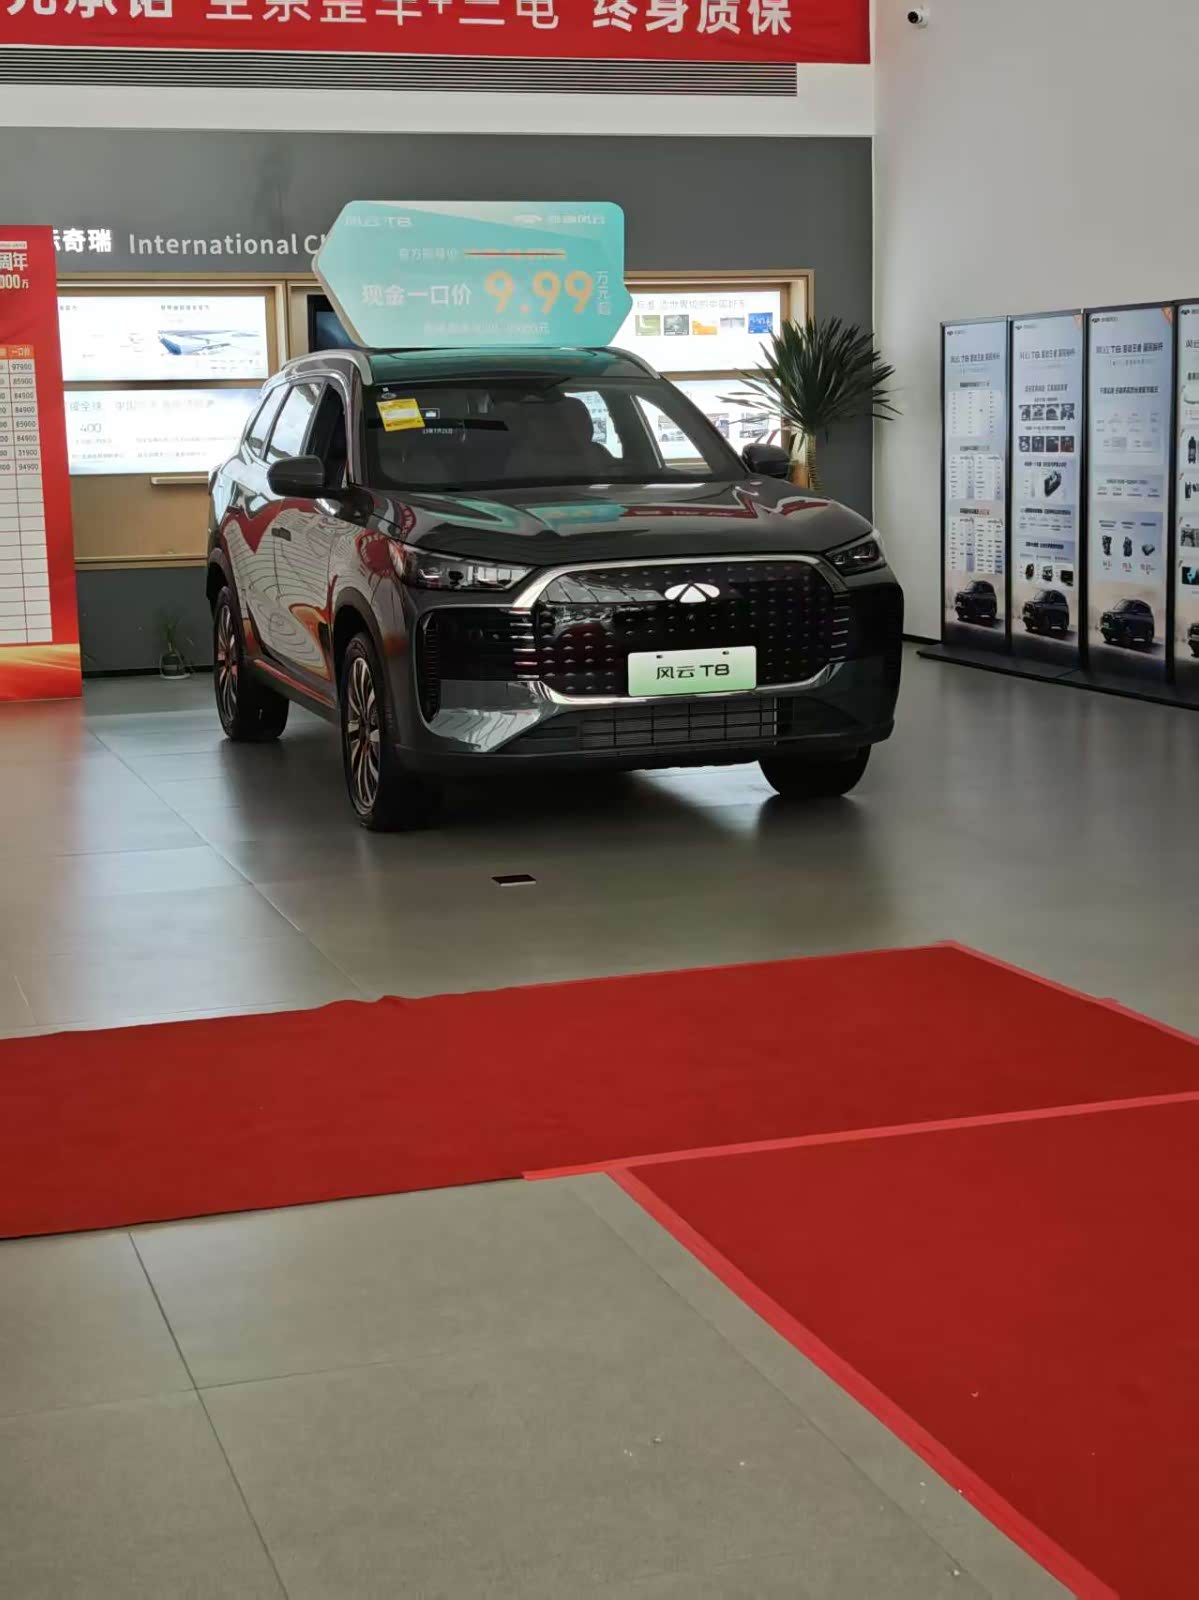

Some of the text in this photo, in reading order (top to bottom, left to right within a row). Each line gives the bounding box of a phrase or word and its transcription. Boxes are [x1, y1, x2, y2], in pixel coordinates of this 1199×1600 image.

[592, 0, 792, 36] 终身质保
[128, 233, 298, 255] International
[361, 282, 472, 306] 现金一口价
[483, 269, 594, 315] 9.99
[656, 663, 730, 680] 风云T8
